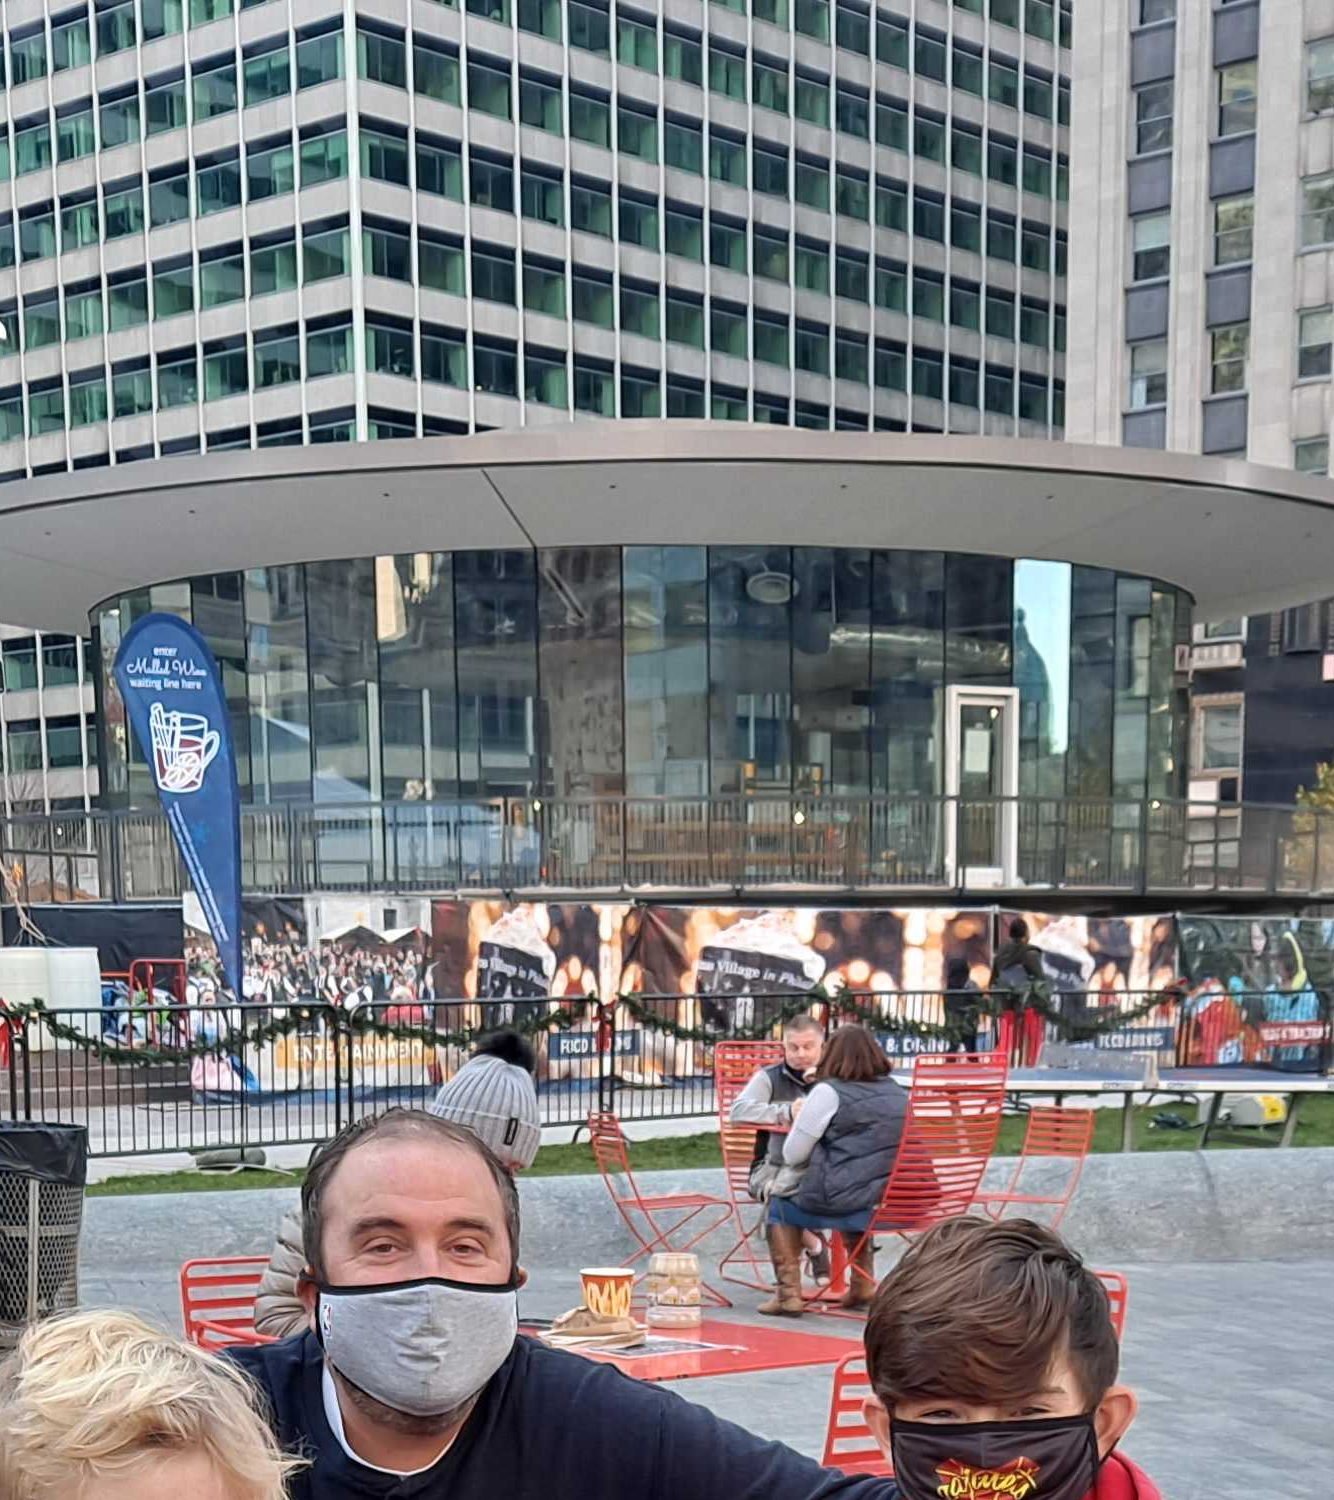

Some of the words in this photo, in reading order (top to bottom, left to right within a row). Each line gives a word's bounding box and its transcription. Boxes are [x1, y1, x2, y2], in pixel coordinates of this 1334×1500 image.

[153, 647, 178, 656] enter
[130, 678, 162, 691] waiting
[164, 678, 179, 688] line
[181, 679, 202, 690] here
[717, 960, 760, 980] Village
[762, 967, 777, 982] in
